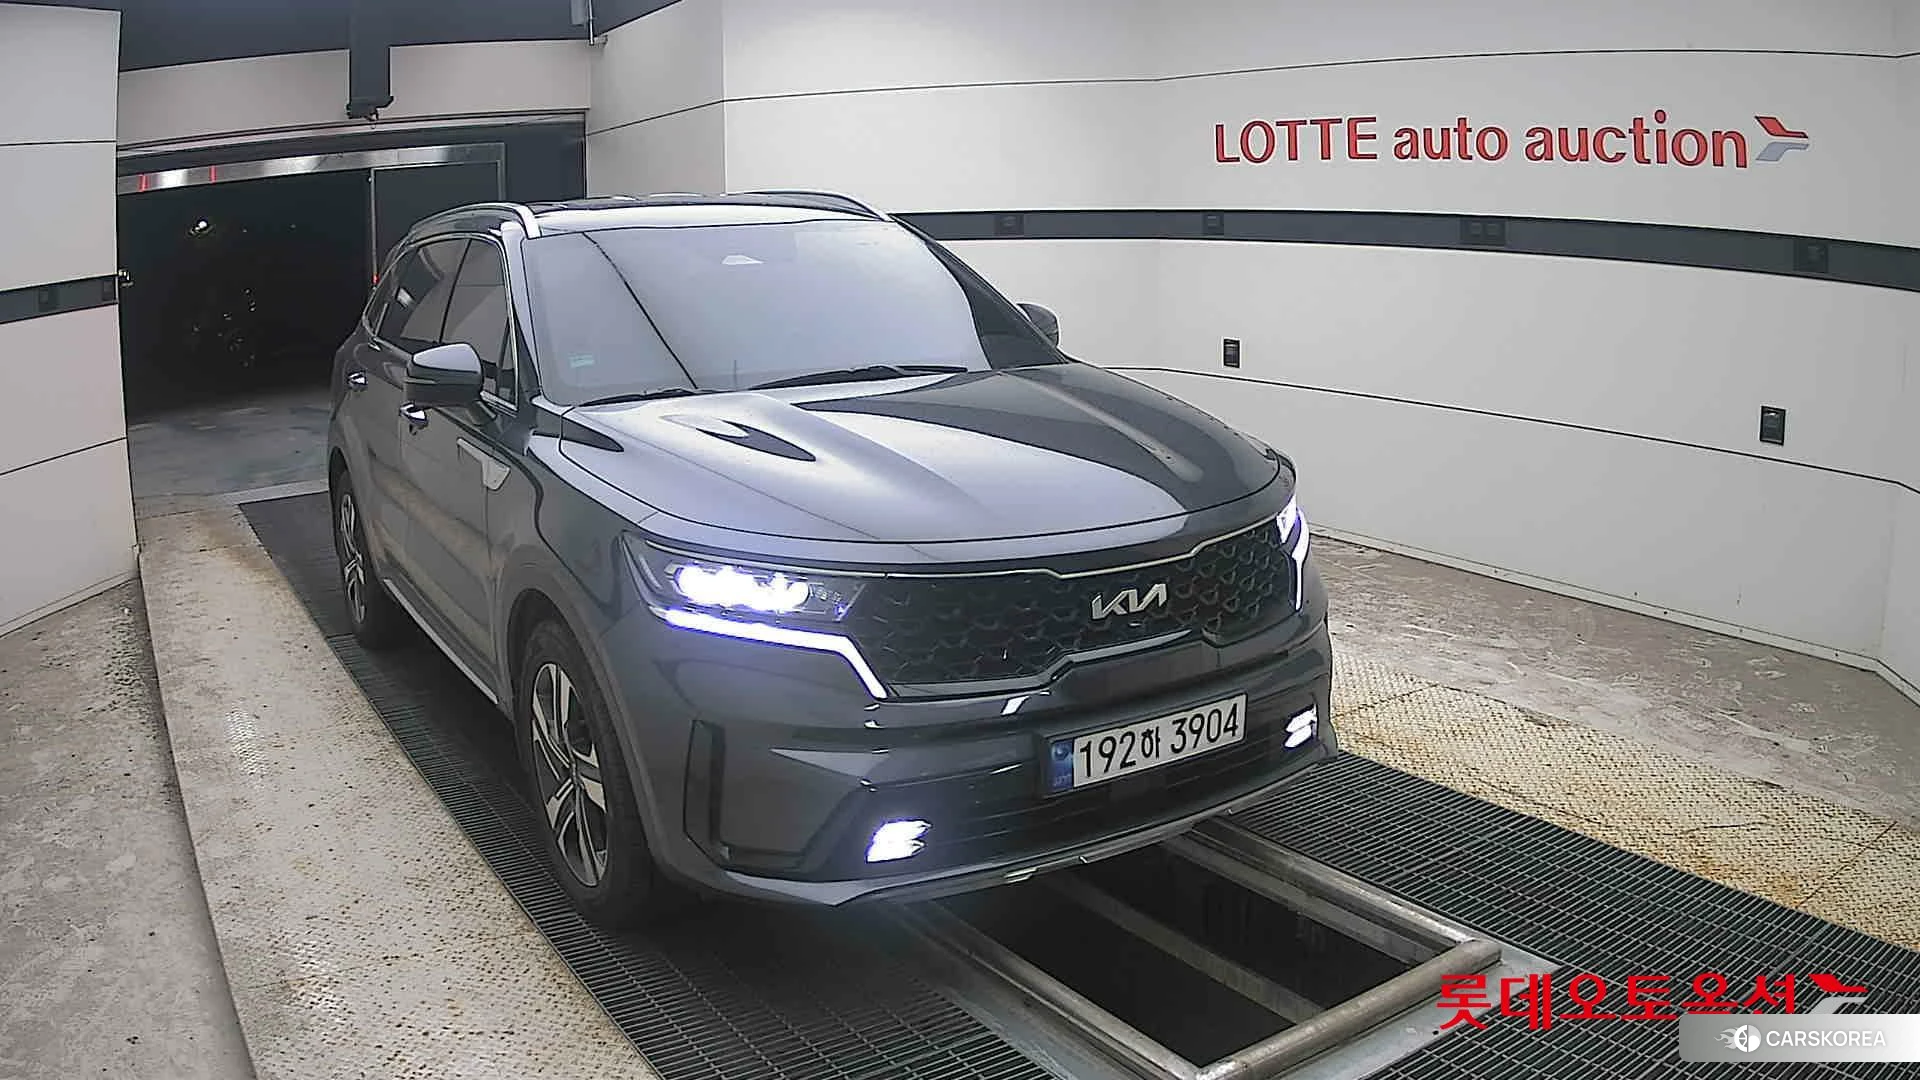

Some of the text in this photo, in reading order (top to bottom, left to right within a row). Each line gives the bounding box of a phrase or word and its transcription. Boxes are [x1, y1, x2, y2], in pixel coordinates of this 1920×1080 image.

[1215, 110, 1748, 168] LOTTE auto auction
[1091, 583, 1168, 620] KIA
[1079, 703, 1239, 778] 192하 3904
